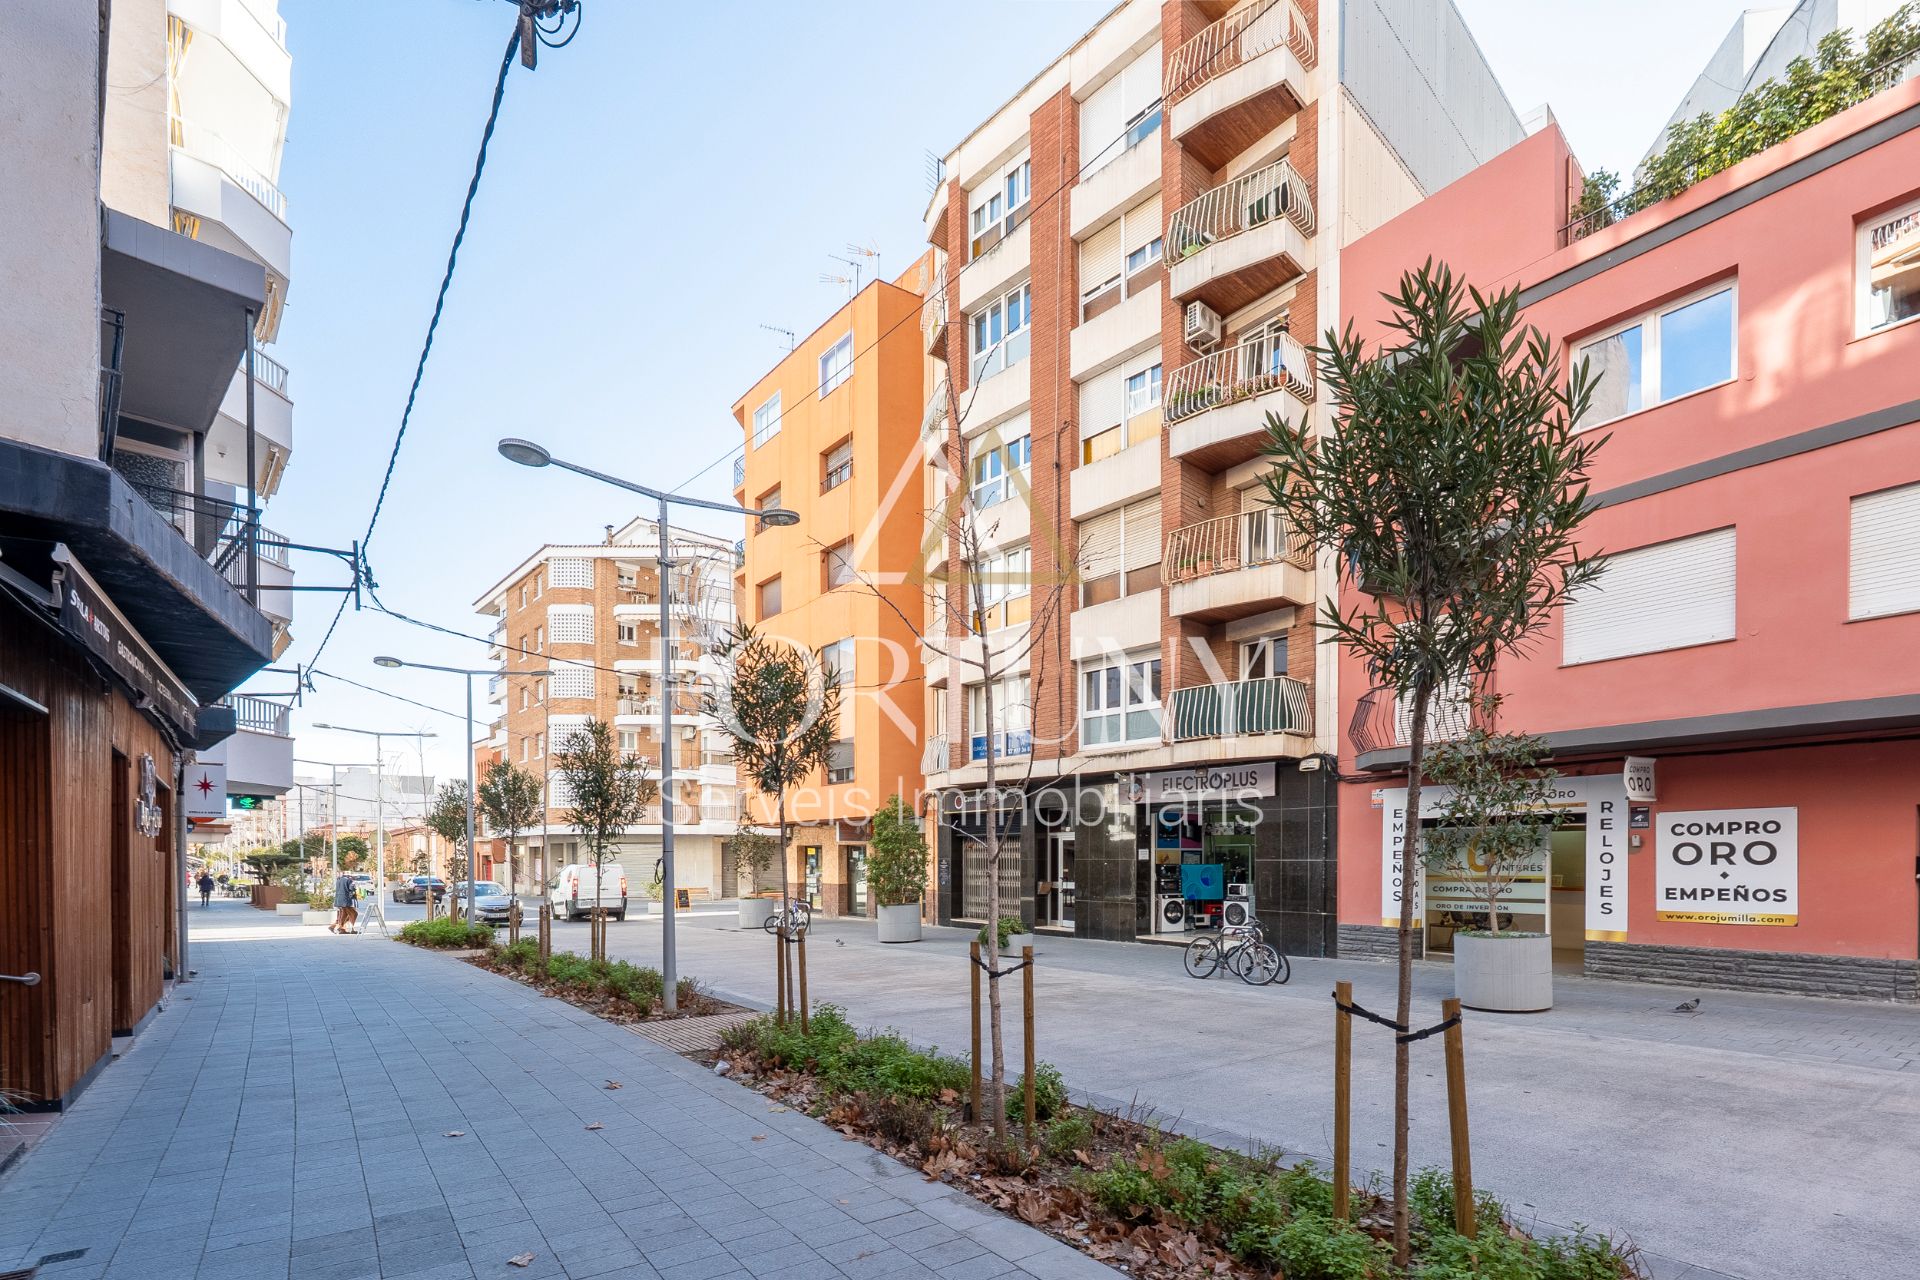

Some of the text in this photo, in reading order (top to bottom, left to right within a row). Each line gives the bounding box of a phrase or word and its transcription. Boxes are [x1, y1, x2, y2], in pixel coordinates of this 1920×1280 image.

[1629, 765, 1650, 773] COMPRO
[1162, 770, 1258, 791] ELECTROPLUS
[1628, 776, 1651, 792] ORO
[1670, 819, 1782, 837] COMPRO
[1392, 808, 1403, 902] EMPEÑOS
[1599, 801, 1614, 915] RELOJES
[1671, 840, 1778, 866] ORO
[1664, 884, 1788, 903] EMPEÑOS
[1665, 914, 1785, 924] www.orojumilla.com
